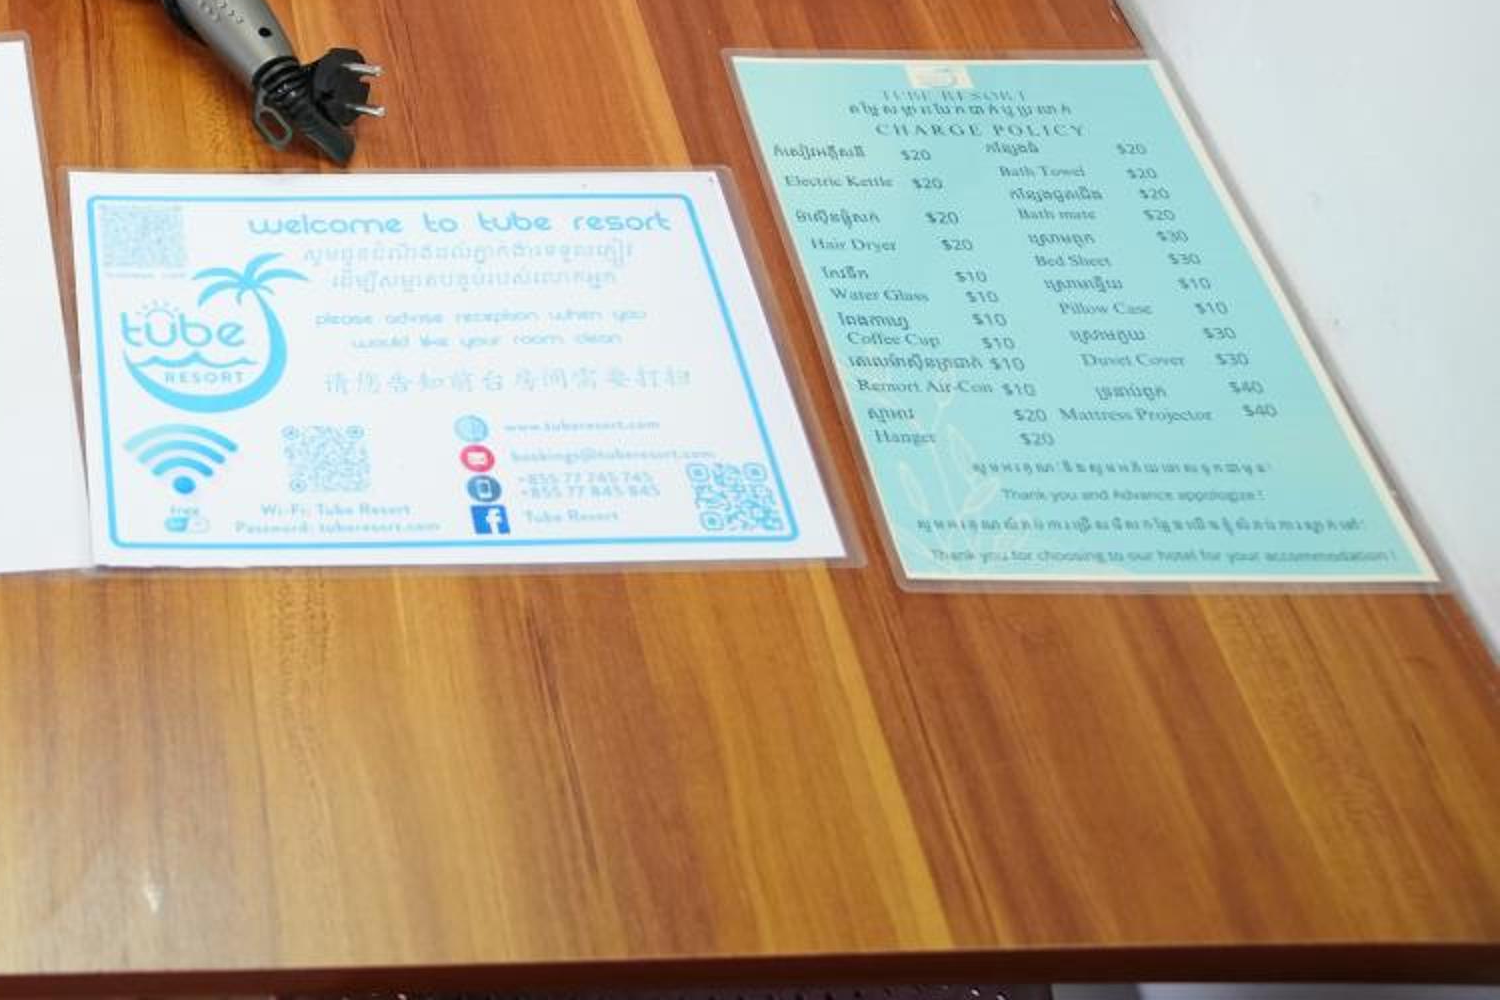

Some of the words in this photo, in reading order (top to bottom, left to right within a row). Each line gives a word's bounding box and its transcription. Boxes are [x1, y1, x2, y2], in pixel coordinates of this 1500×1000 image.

[874, 123, 983, 137] CHARGE
[993, 123, 1086, 137] POLICY
[900, 149, 932, 162] $20
[1116, 143, 1147, 155] $20
[1000, 166, 1035, 178] Bath
[1041, 166, 1086, 178] Towel
[1127, 168, 1158, 180] $20
[785, 175, 842, 188] Electric
[845, 175, 894, 188] Kettle
[912, 177, 943, 190] $20
[1140, 188, 1171, 200] $20
[926, 212, 959, 225] $20
[1018, 208, 1056, 221] Bath
[1144, 209, 1176, 222] $20
[247, 212, 404, 236] welcome
[422, 212, 458, 233] to
[477, 211, 552, 233] tube
[572, 210, 672, 232] resort
[811, 238, 846, 250] Hair
[851, 238, 898, 253] Dryer
[942, 238, 973, 251] $20
[1035, 254, 1066, 267] Bed
[1068, 254, 1112, 267] Sheet
[1168, 253, 1201, 265] $30
[955, 271, 988, 283] $10
[1178, 277, 1212, 290] $10
[830, 287, 879, 300] Water
[884, 289, 930, 302] Glass
[966, 291, 999, 303] $10
[1059, 301, 1109, 315] Pillow
[1113, 301, 1154, 315] Case
[1194, 300, 1229, 315] $10
[315, 311, 373, 328] please
[549, 307, 603, 322] when
[612, 309, 647, 323] you
[972, 313, 1008, 327] $10
[120, 310, 245, 349] tube
[1203, 327, 1237, 340] $30
[460, 335, 502, 351] your
[513, 334, 564, 346] room
[847, 332, 901, 346] Coffee
[904, 333, 942, 348] Cup
[982, 336, 1016, 350] $10
[989, 356, 1026, 372] $10
[1080, 353, 1133, 367] Duvet
[1136, 353, 1186, 367] Cover
[1215, 352, 1250, 366] $30
[164, 369, 245, 385] RESORT
[1002, 383, 1037, 397] $10
[1228, 380, 1265, 394] $40
[1013, 408, 1048, 422] $20
[1058, 407, 1135, 422] Mattress
[1136, 407, 1214, 425] Projector
[1242, 404, 1279, 418] $40
[874, 429, 937, 445] Hanger
[1019, 432, 1056, 447] $20
[1002, 489, 1046, 500] Thank
[1050, 490, 1078, 503] you
[318, 501, 354, 517] Tube
[358, 500, 412, 516] Resort
[525, 509, 563, 524] Tube
[567, 508, 619, 523] Resort
